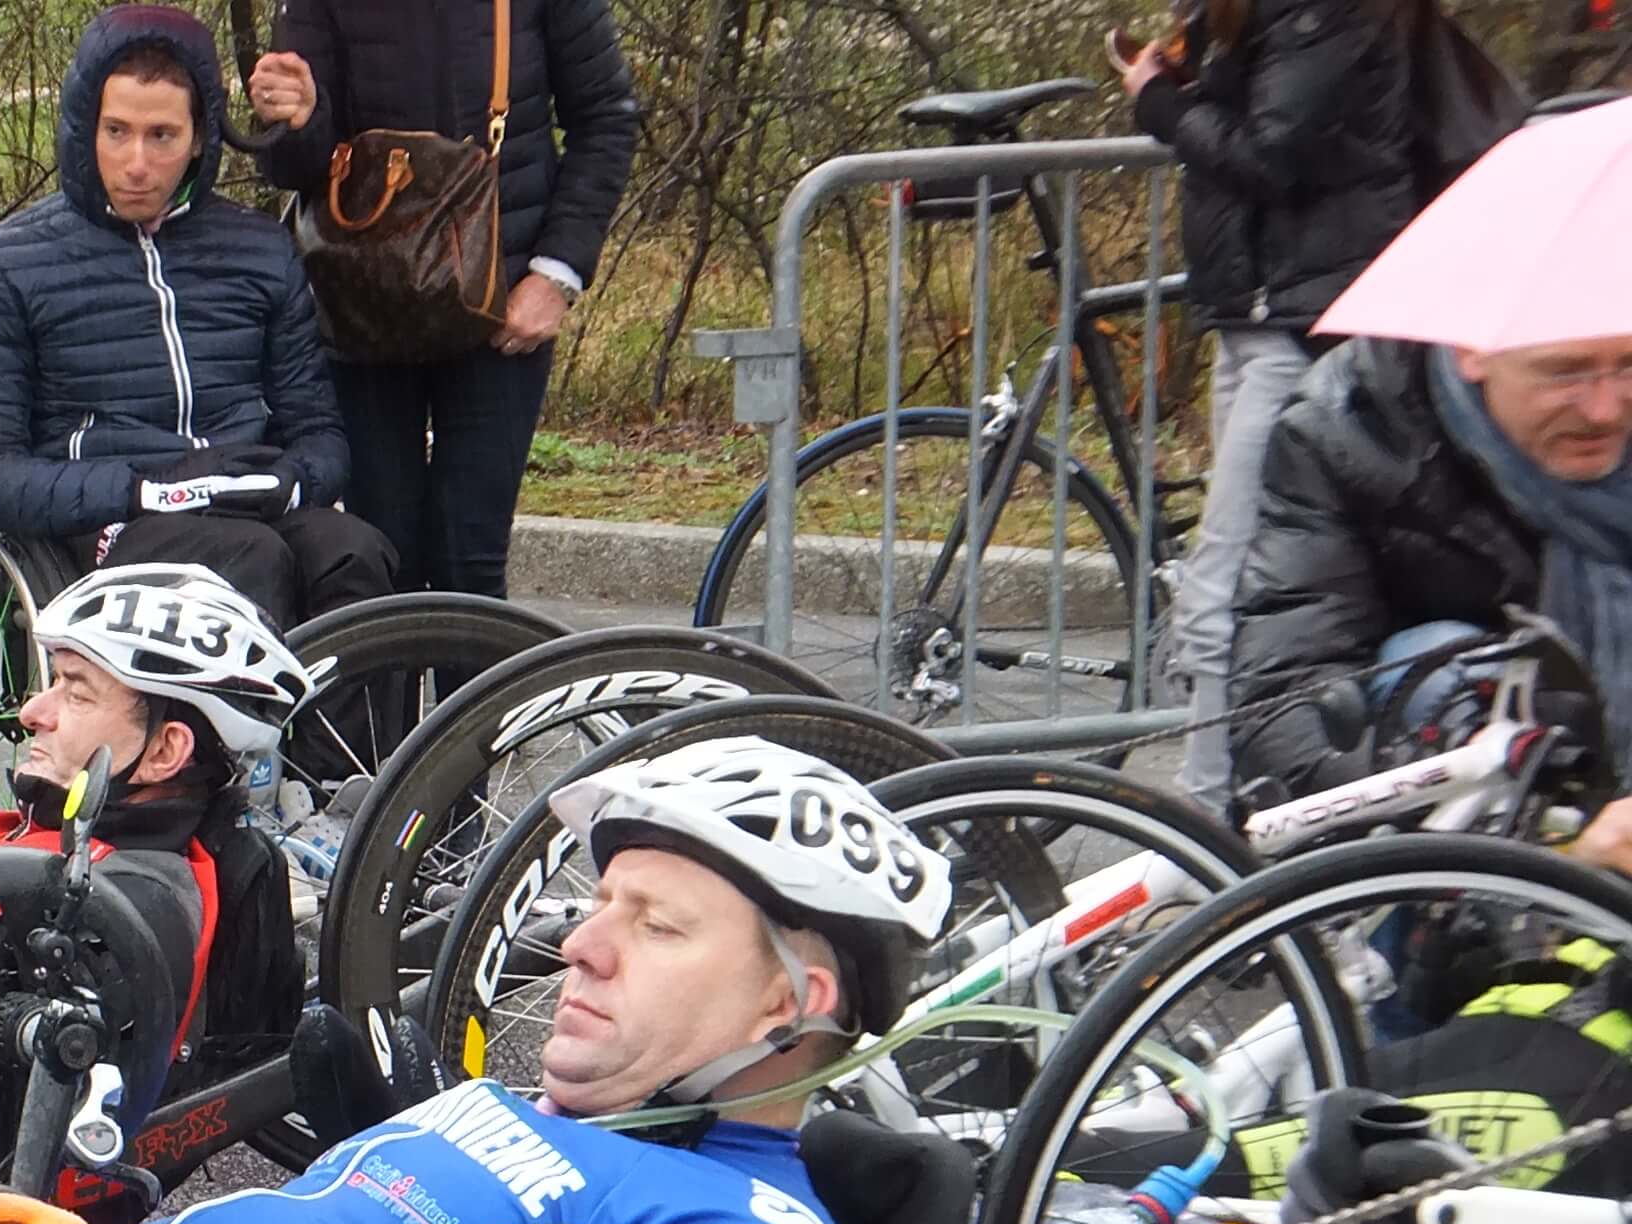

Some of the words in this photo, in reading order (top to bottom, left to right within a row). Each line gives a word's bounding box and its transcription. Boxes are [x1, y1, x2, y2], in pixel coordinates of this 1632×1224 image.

[106, 590, 232, 657] 113
[492, 671, 753, 752] ZIPP
[787, 787, 928, 903] 099
